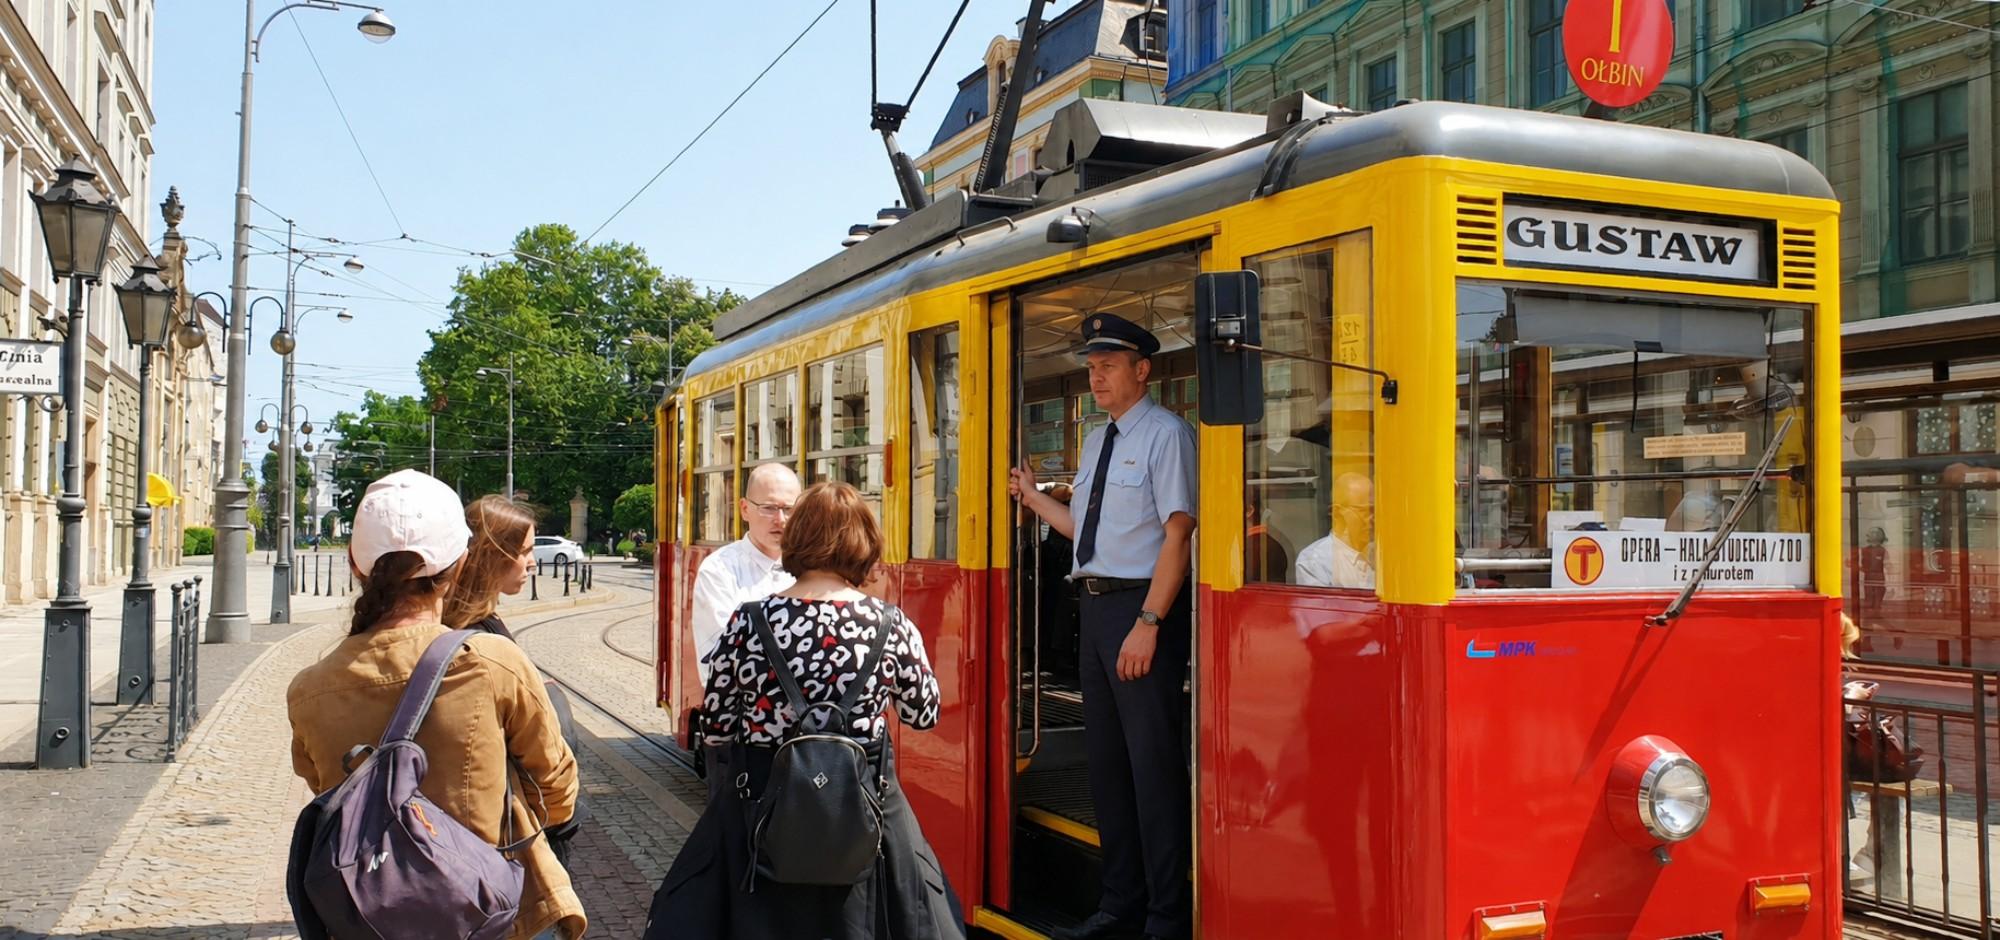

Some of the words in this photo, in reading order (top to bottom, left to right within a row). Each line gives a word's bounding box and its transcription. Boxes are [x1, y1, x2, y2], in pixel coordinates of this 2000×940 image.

[1581, 57, 1644, 88] OŁBIN
[1506, 216, 1743, 265] GUSTAW
[1621, 537, 1661, 562] OPERA
[1679, 537, 1709, 562] HALA
[1499, 641, 1537, 656] MPK
